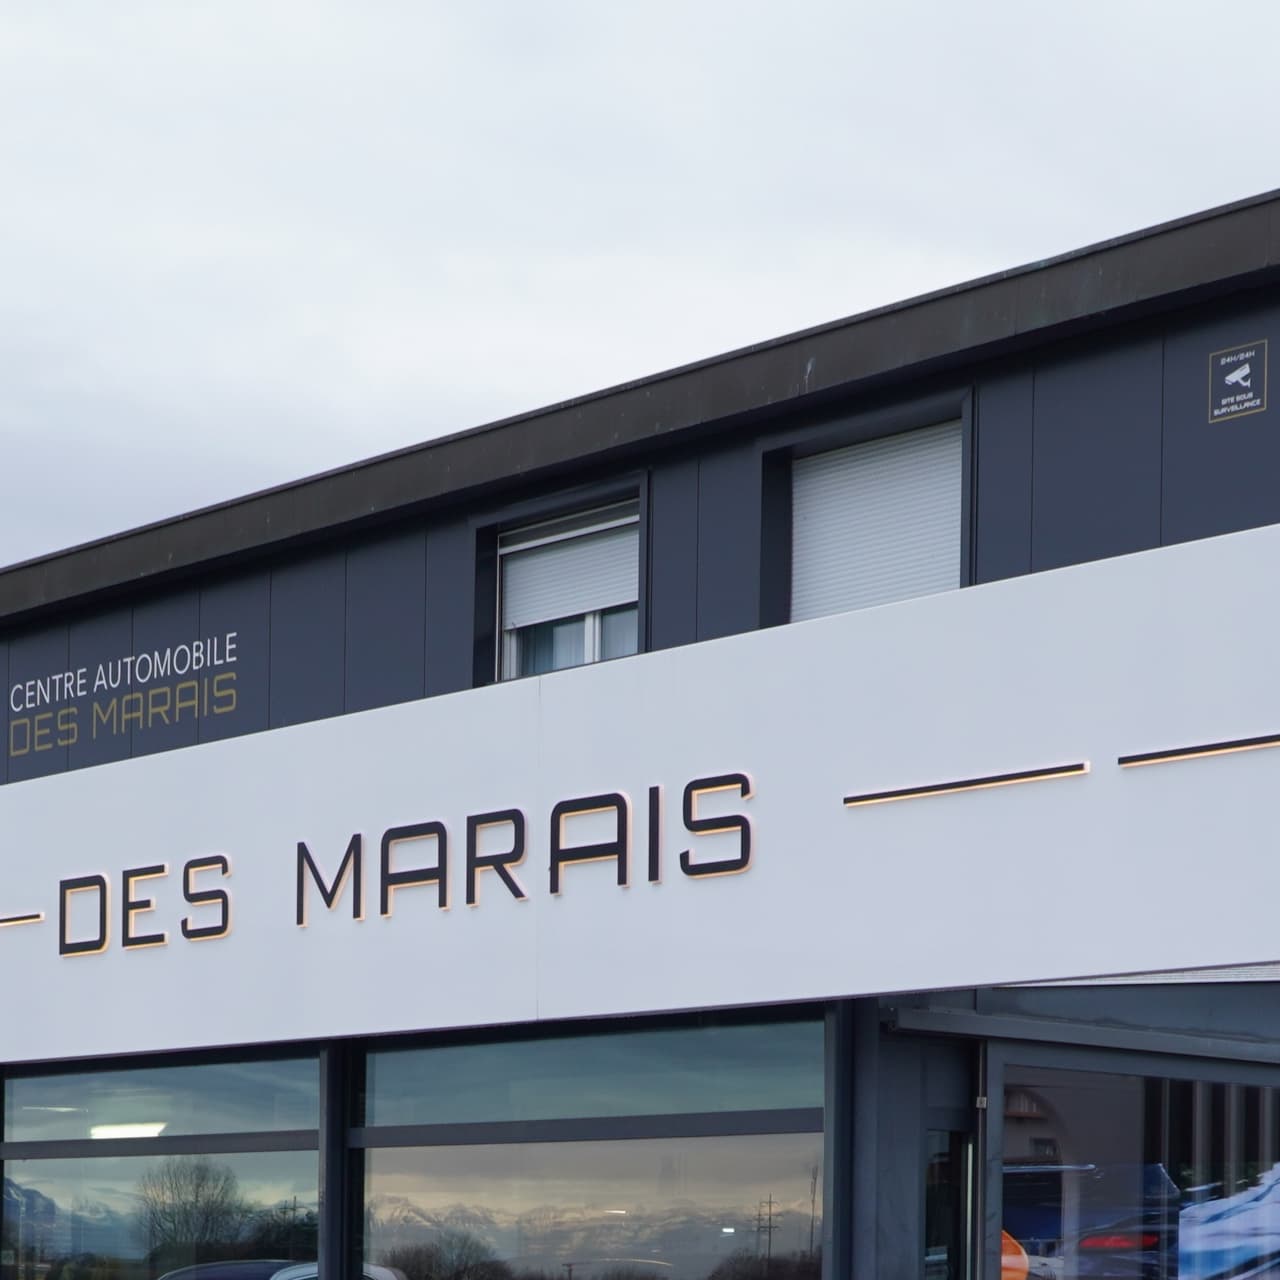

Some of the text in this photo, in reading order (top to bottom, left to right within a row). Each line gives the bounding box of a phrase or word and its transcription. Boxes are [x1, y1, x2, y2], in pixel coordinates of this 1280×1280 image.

[9, 671, 238, 757] DES MARAIS
[10, 632, 238, 712] CENTRE AUTOMOBILE
[58, 854, 234, 959] DES
[295, 772, 754, 928] MARAIS
